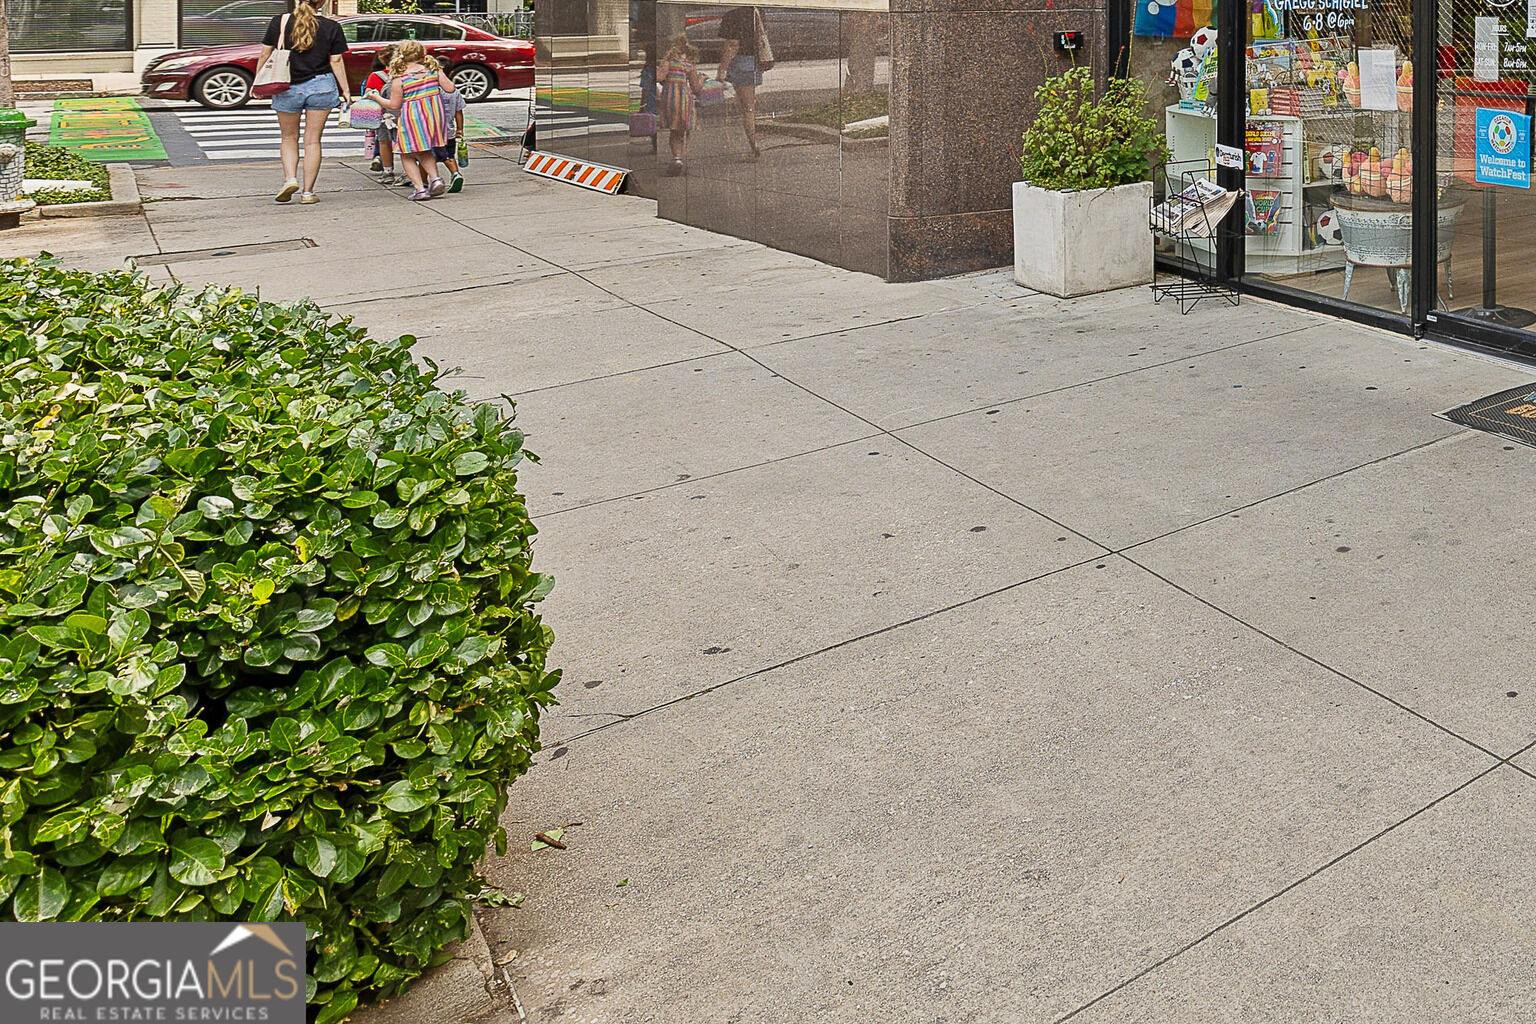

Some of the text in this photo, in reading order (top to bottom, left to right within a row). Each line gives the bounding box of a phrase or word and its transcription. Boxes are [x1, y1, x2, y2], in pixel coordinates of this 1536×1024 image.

[1480, 153, 1526, 168] Welcome to
[1480, 165, 1526, 181] WatchFest
